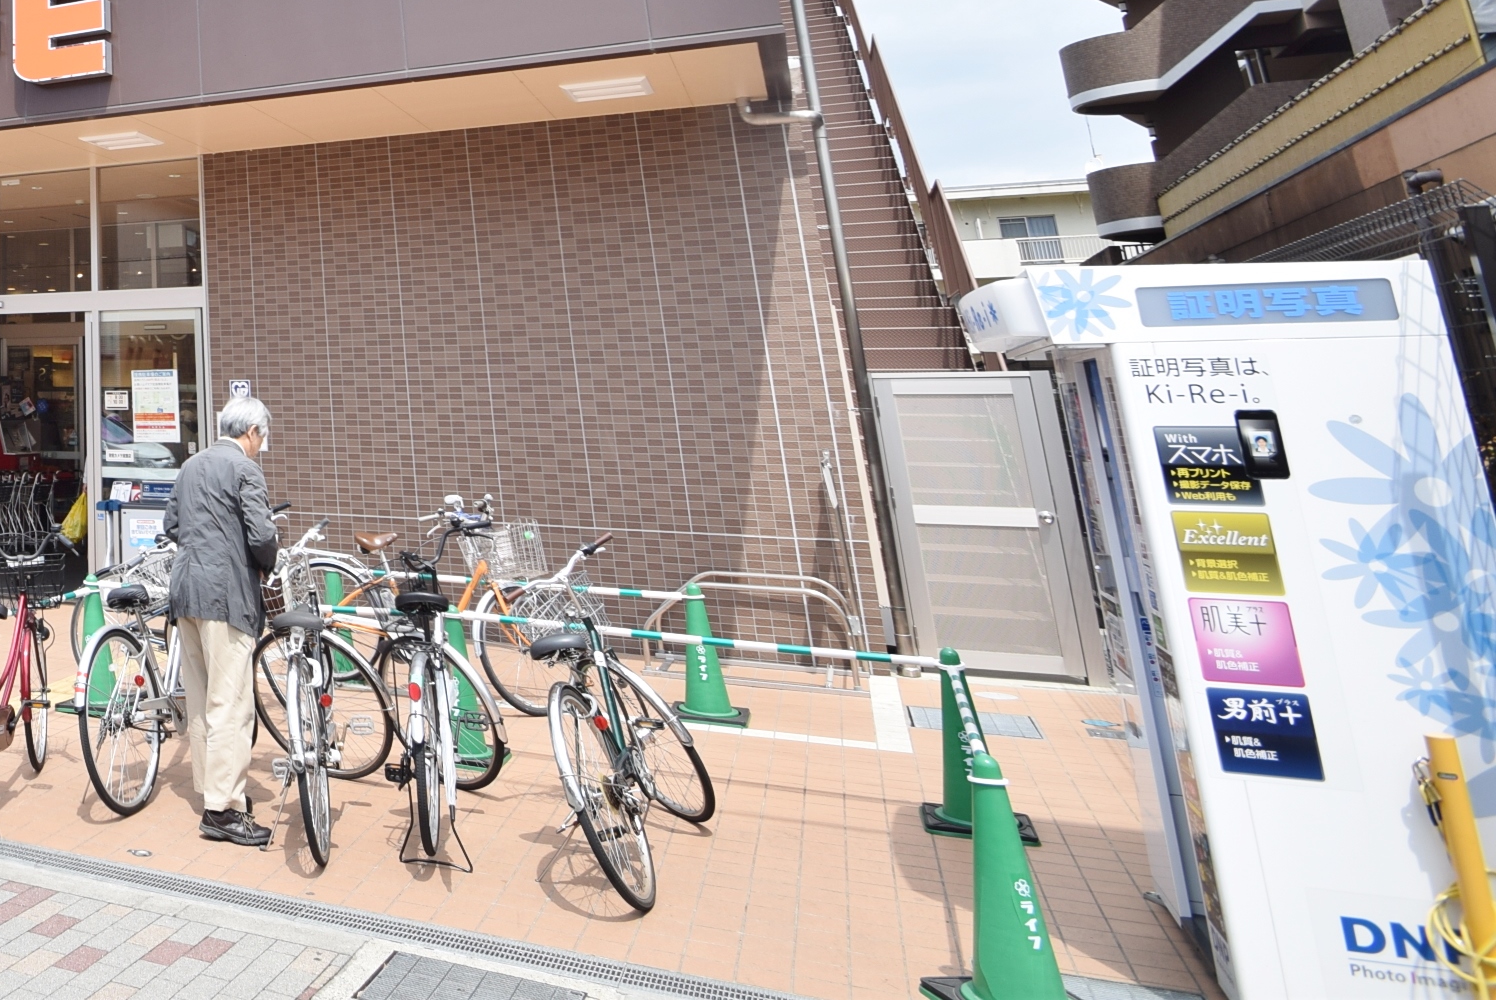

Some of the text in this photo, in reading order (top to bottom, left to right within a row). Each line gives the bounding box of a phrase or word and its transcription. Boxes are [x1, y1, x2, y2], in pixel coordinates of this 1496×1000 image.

[1167, 286, 1363, 320] 証明写真
[1129, 357, 1270, 378] 証明写真は、
[1164, 433, 1198, 443] With
[1168, 444, 1243, 465] スマホ
[1177, 468, 1231, 478] 再プリント
[1179, 480, 1252, 490] 撮影データ保存
[1181, 491, 1237, 501] Web利用も
[1182, 529, 1269, 547] Excellent
[1195, 558, 1239, 569] 背景選択
[698, 655, 708, 681] ライフ
[1216, 660, 1260, 672] 肌色補正
[1234, 748, 1279, 761] 肌色補正
[1020, 901, 1042, 950] ライフ
[1349, 963, 1407, 983] Photo
